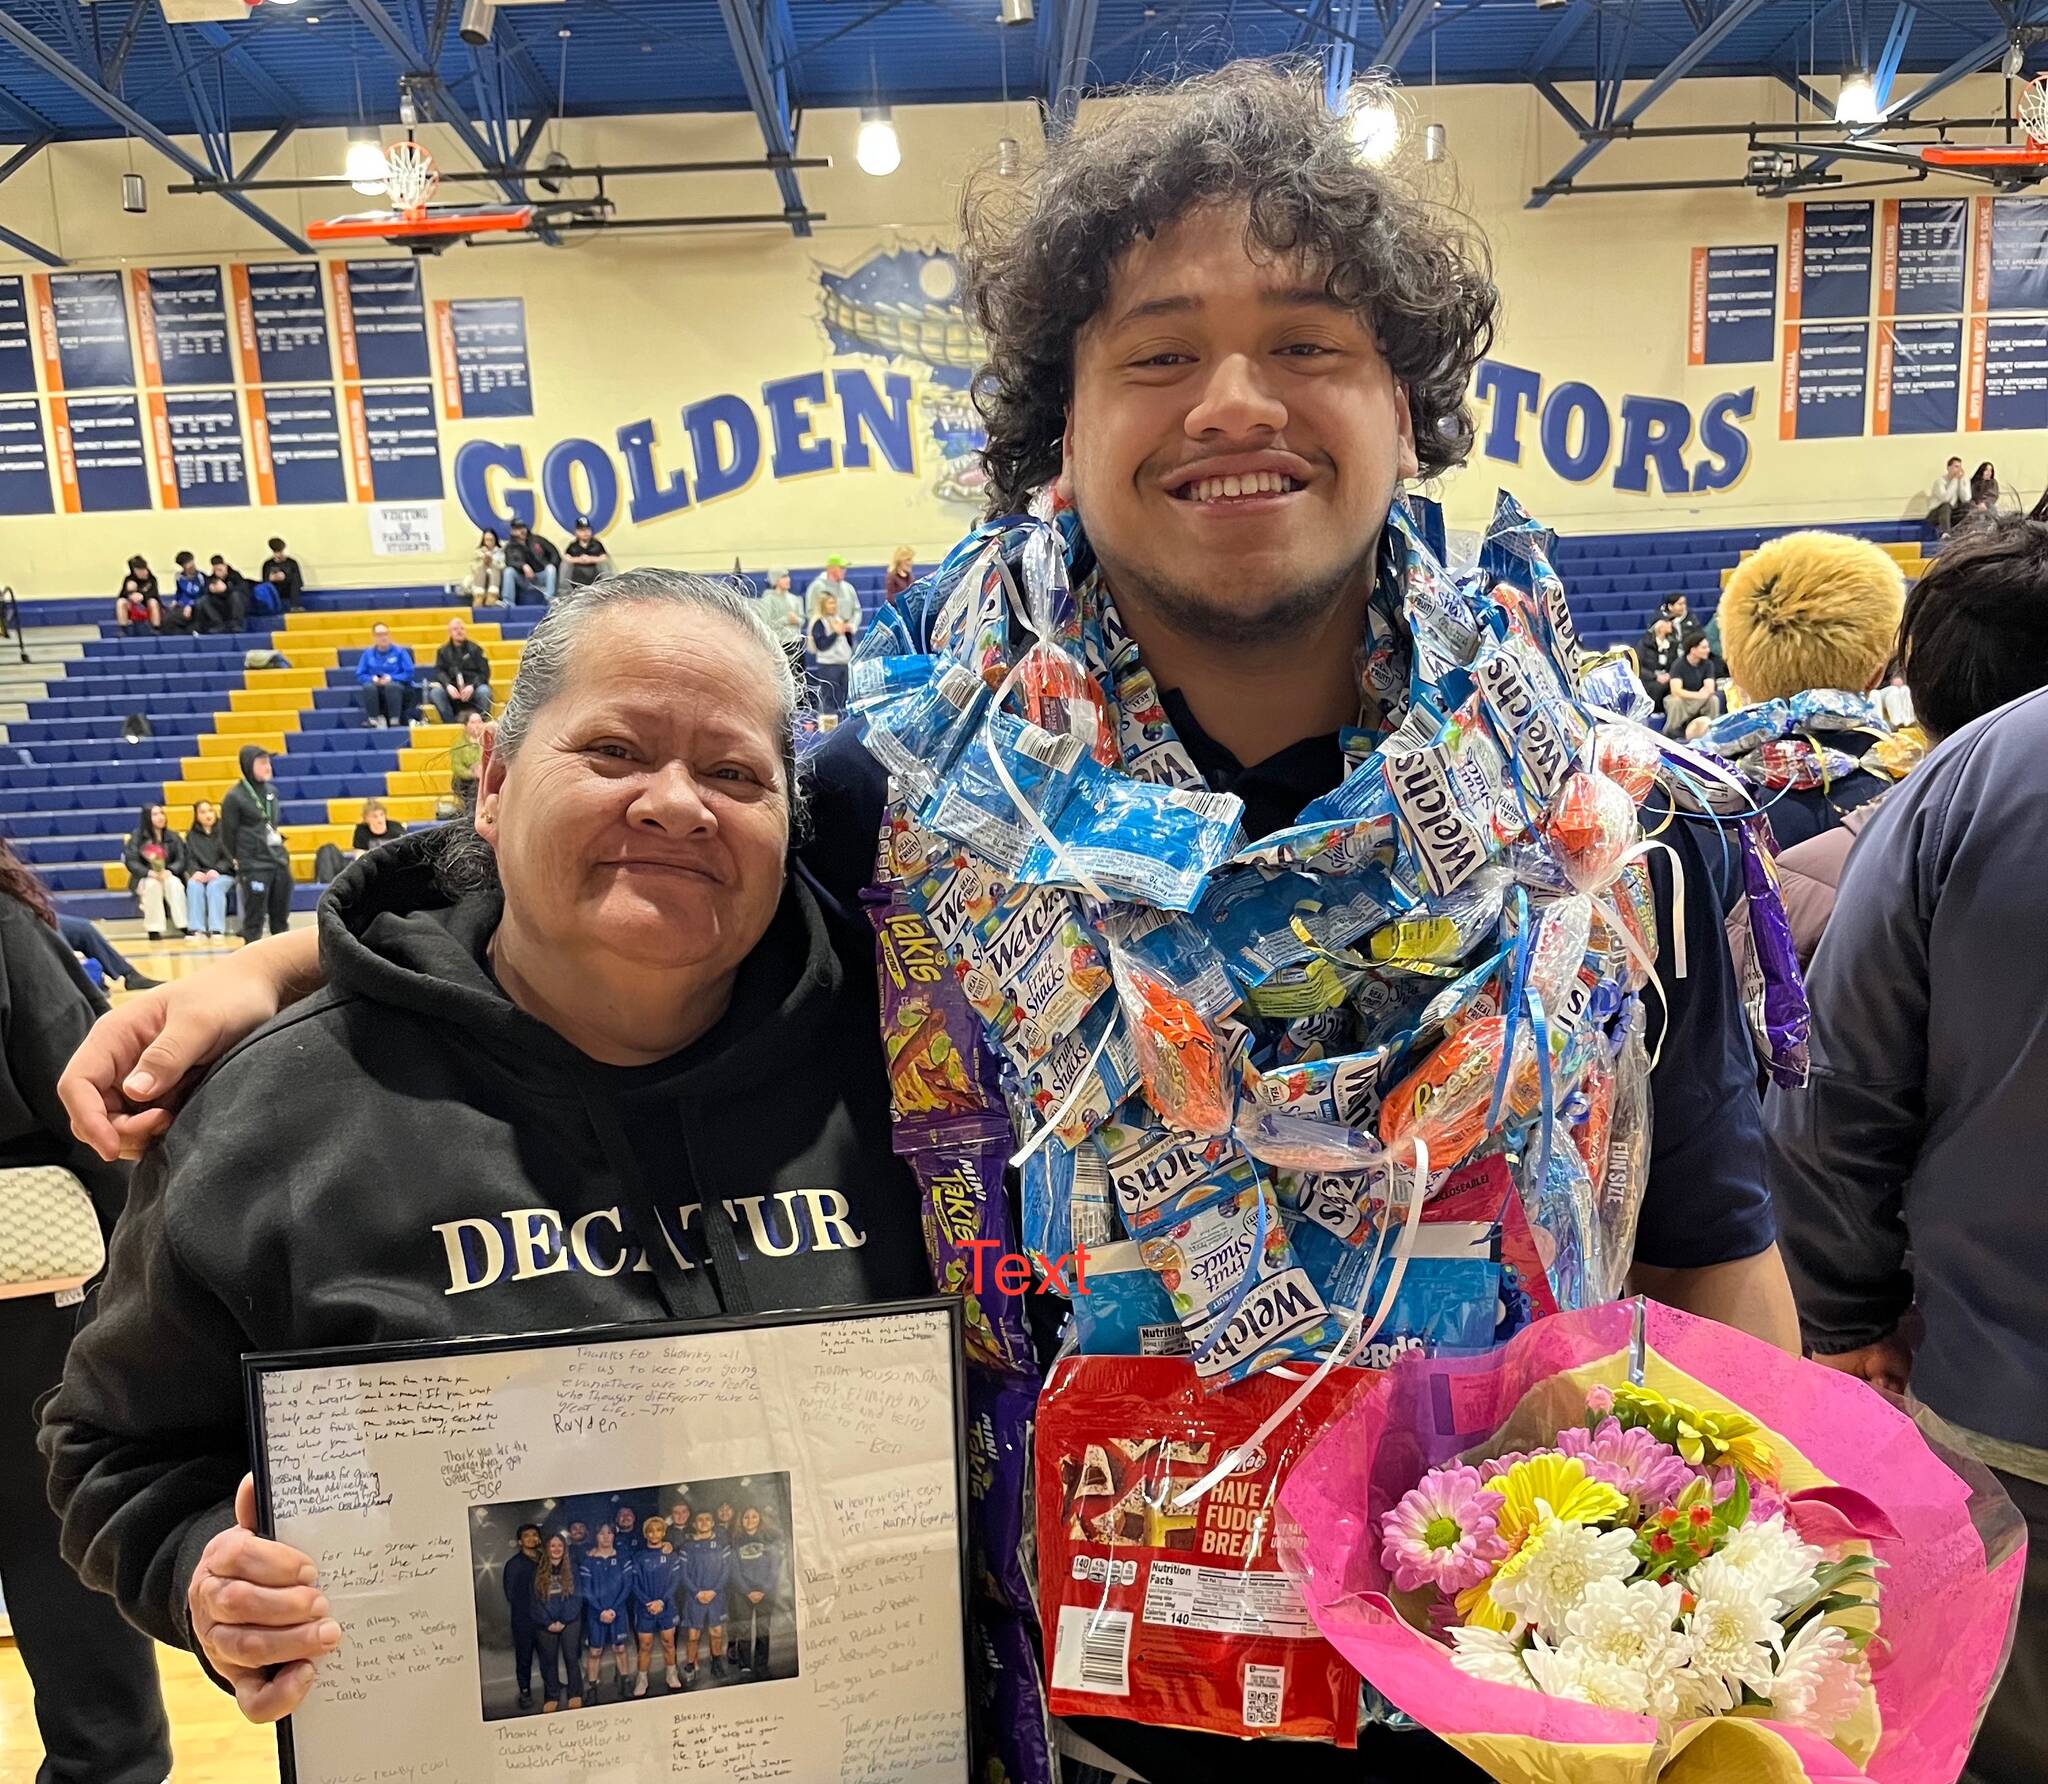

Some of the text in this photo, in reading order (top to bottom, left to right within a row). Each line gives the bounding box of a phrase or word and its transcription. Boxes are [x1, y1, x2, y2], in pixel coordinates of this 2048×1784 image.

[1883, 264, 1894, 290] BOYS
[1475, 358, 1756, 494] TORS
[454, 368, 915, 538] GOLDEN
[1395, 750, 1477, 885] Welch's
[1026, 962, 1066, 1019] Snacks
[1473, 1000, 1491, 1016] REAL
[1052, 1042, 1087, 1099] Snacks
[1607, 1141, 1629, 1204] FUN SIZE
[1190, 1232, 1252, 1281] Snacks
[1191, 1281, 1319, 1365] Welch's
[552, 1413, 618, 1434] Rayden
[1209, 1480, 1262, 1508] HAVE
[1205, 1504, 1271, 1533] FUDGE
[1201, 1529, 1266, 1557] BREAK
[1075, 1558, 1090, 1569] 140
[1151, 1562, 1191, 1576] Nutrition
[1150, 1574, 1174, 1586] Facts
[1170, 1612, 1190, 1625] 140
